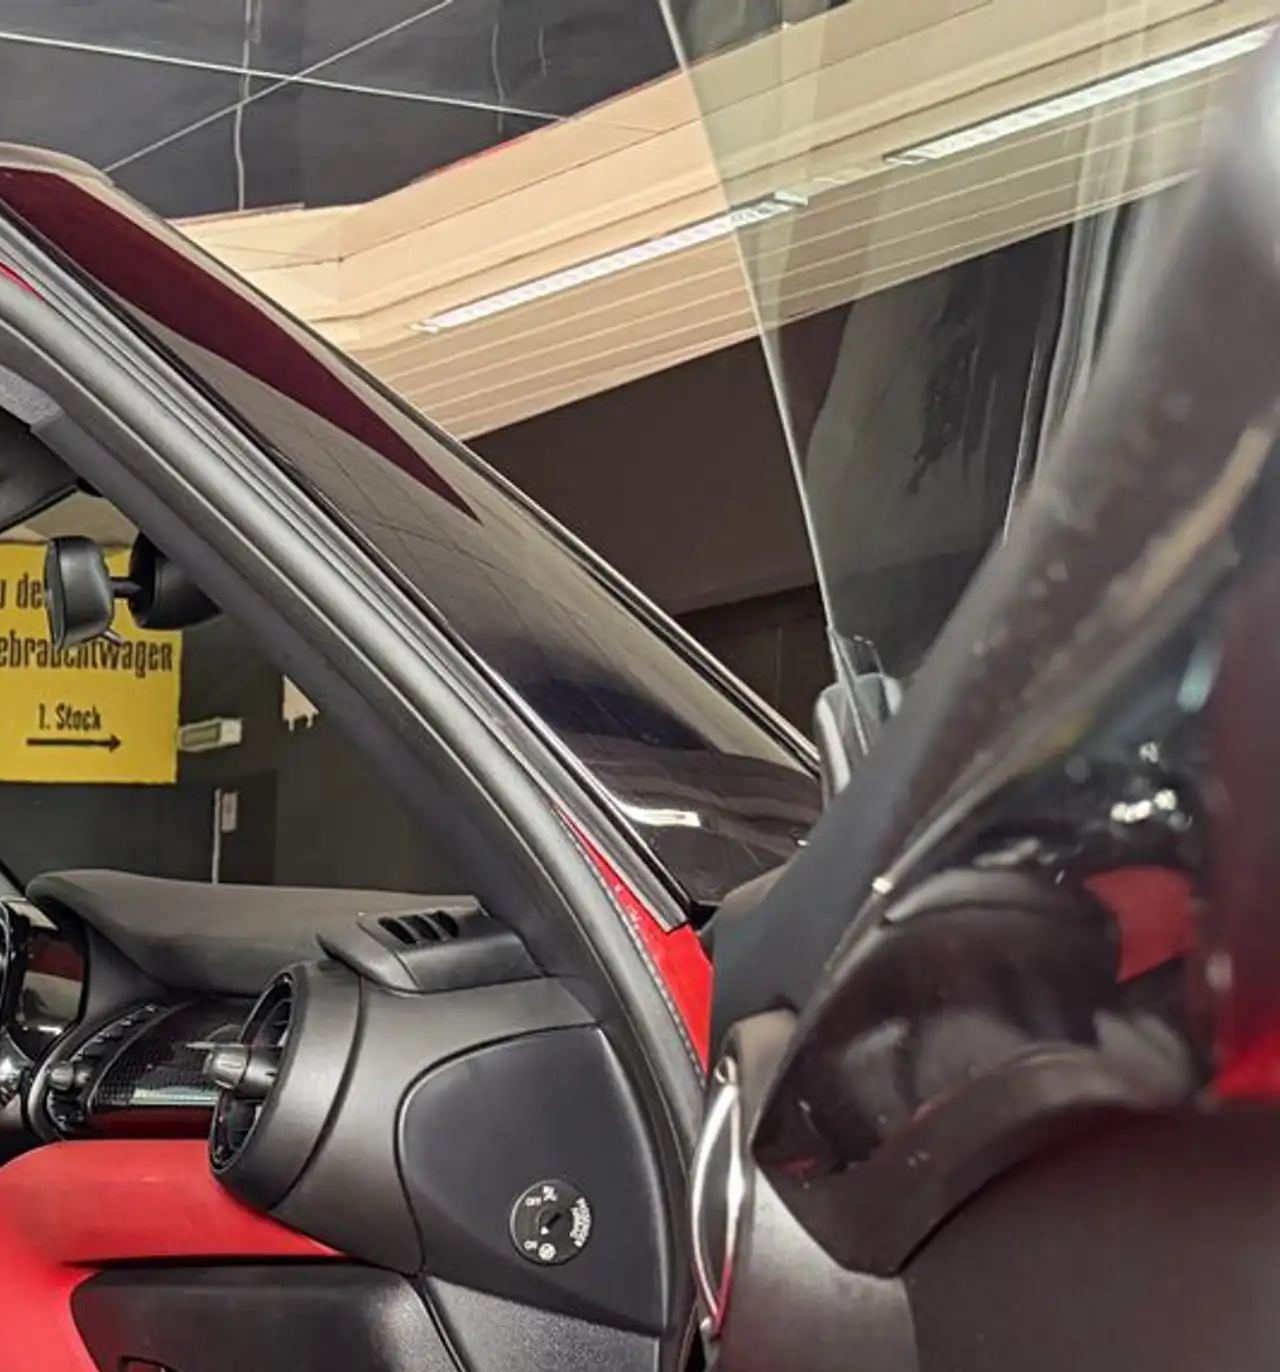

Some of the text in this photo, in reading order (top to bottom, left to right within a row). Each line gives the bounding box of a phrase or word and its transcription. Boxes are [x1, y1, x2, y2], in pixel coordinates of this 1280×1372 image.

[15, 571, 48, 610] de
[38, 703, 101, 731] 1. Stock
